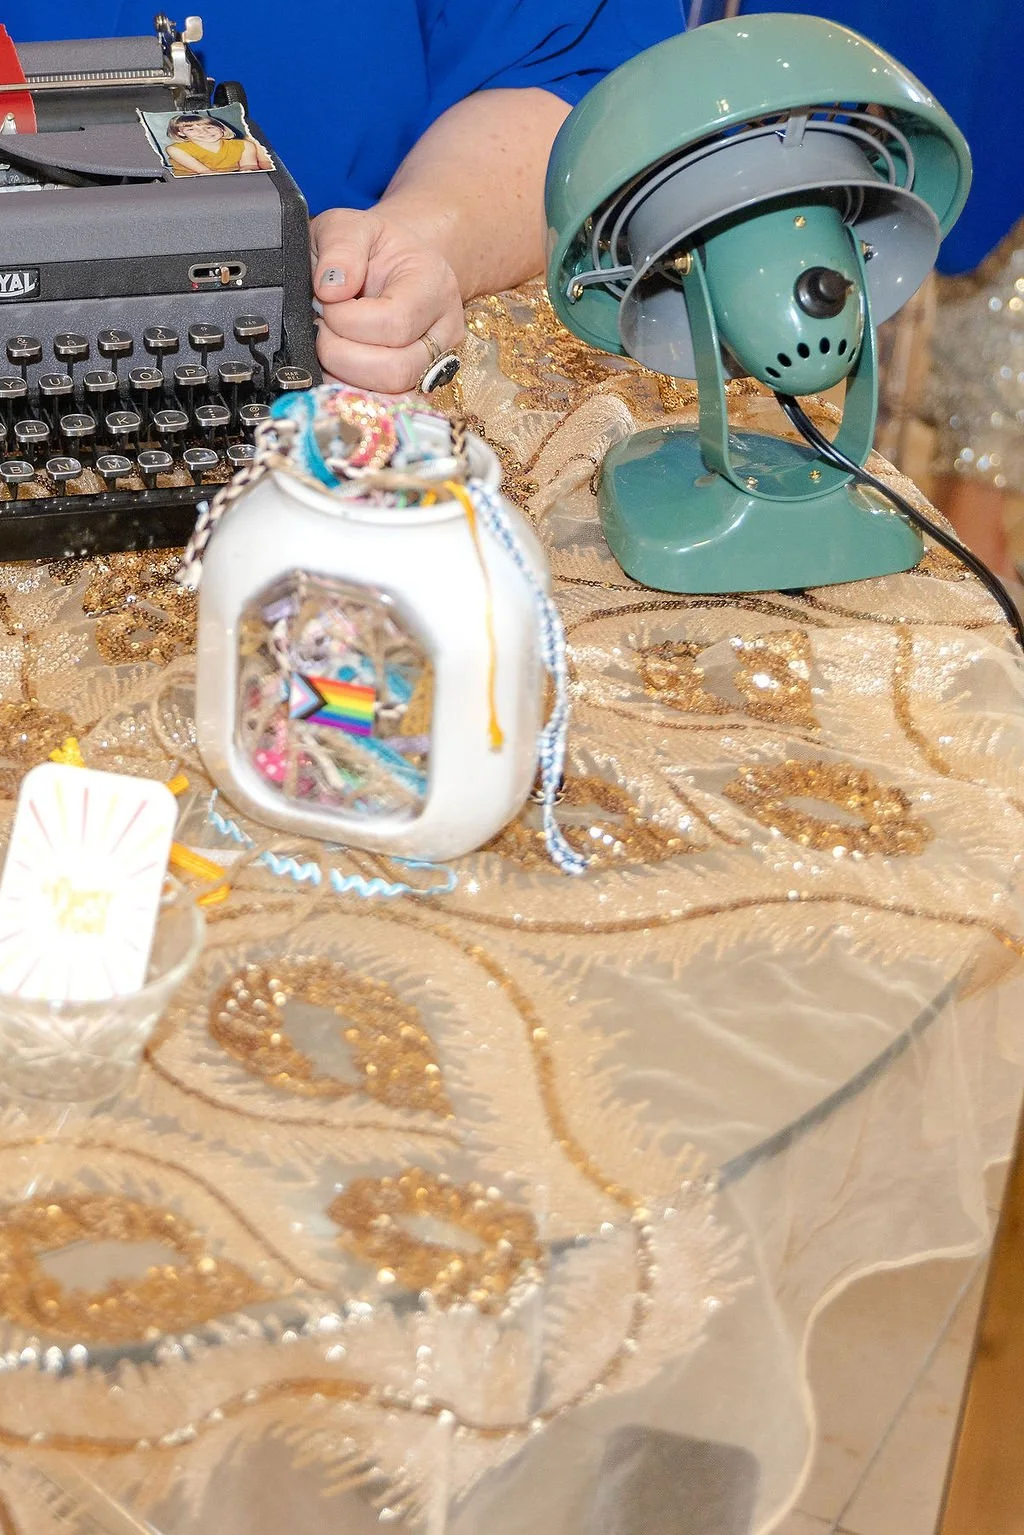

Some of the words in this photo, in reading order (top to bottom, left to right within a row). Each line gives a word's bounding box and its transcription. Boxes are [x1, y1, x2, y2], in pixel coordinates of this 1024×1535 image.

[139, 372, 152, 380] O
[185, 369, 196, 377] P
[3, 381, 14, 389] Y
[48, 377, 61, 386] U
[73, 419, 83, 427] J
[117, 416, 129, 425] K
[164, 416, 178, 424] L
[25, 425, 38, 434] H
[57, 463, 70, 471] N
[106, 460, 121, 469] M
[10, 466, 23, 474] B
